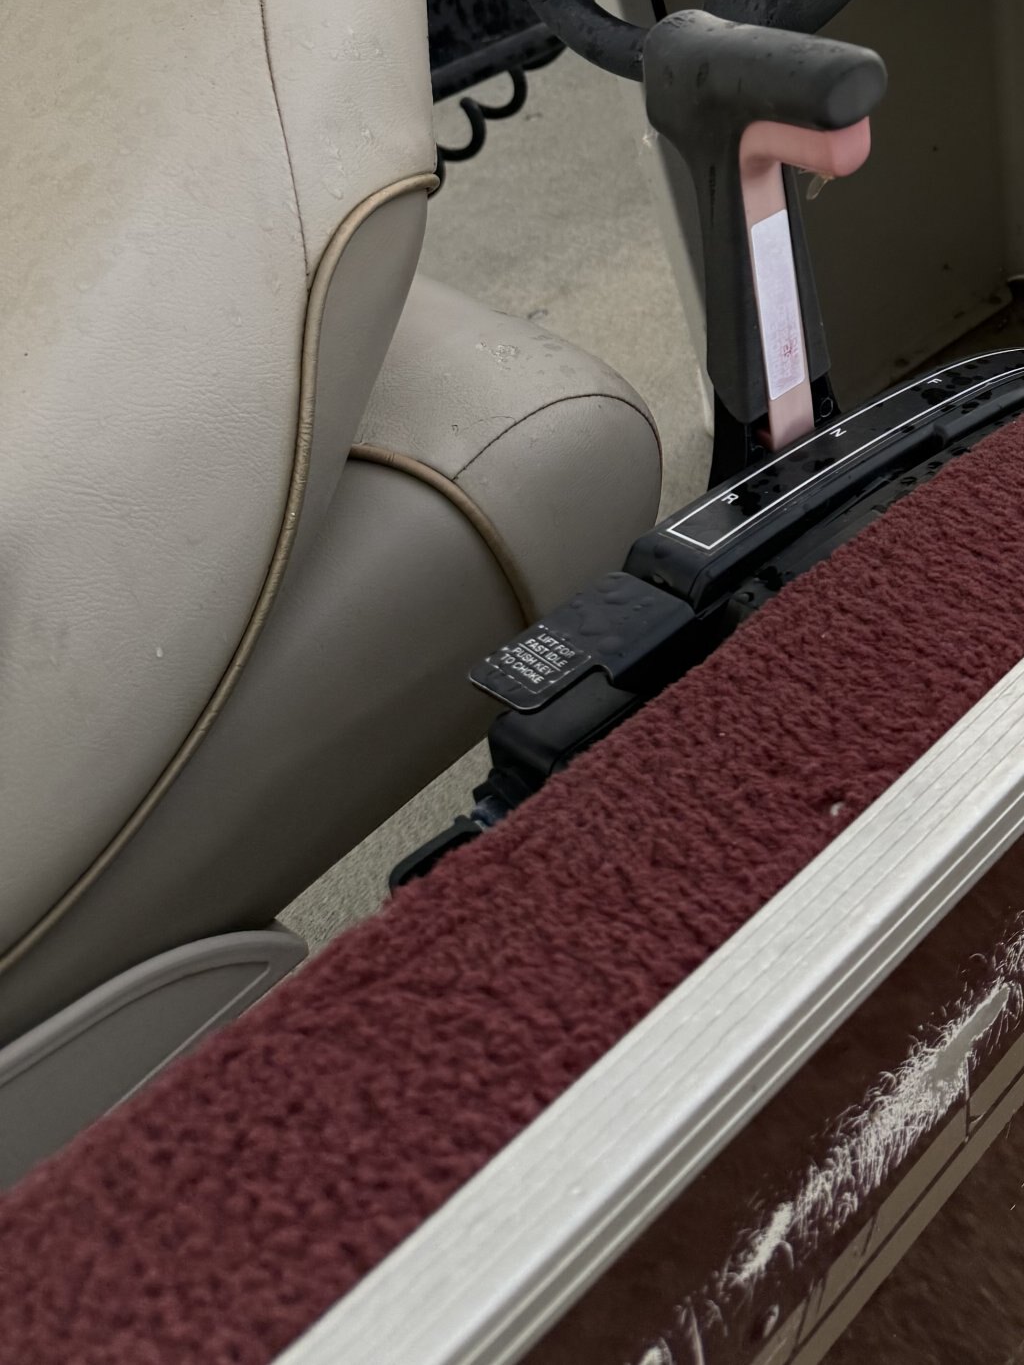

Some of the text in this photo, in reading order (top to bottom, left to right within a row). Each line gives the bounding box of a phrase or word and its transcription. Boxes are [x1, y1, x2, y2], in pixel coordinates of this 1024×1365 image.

[831, 426, 847, 438] N
[722, 492, 739, 504] R
[525, 638, 568, 667] FAST IDLE
[537, 634, 576, 658] LIFT FOR
[500, 653, 545, 684] TO CHOKE
[511, 646, 555, 676] PUSH KEY
